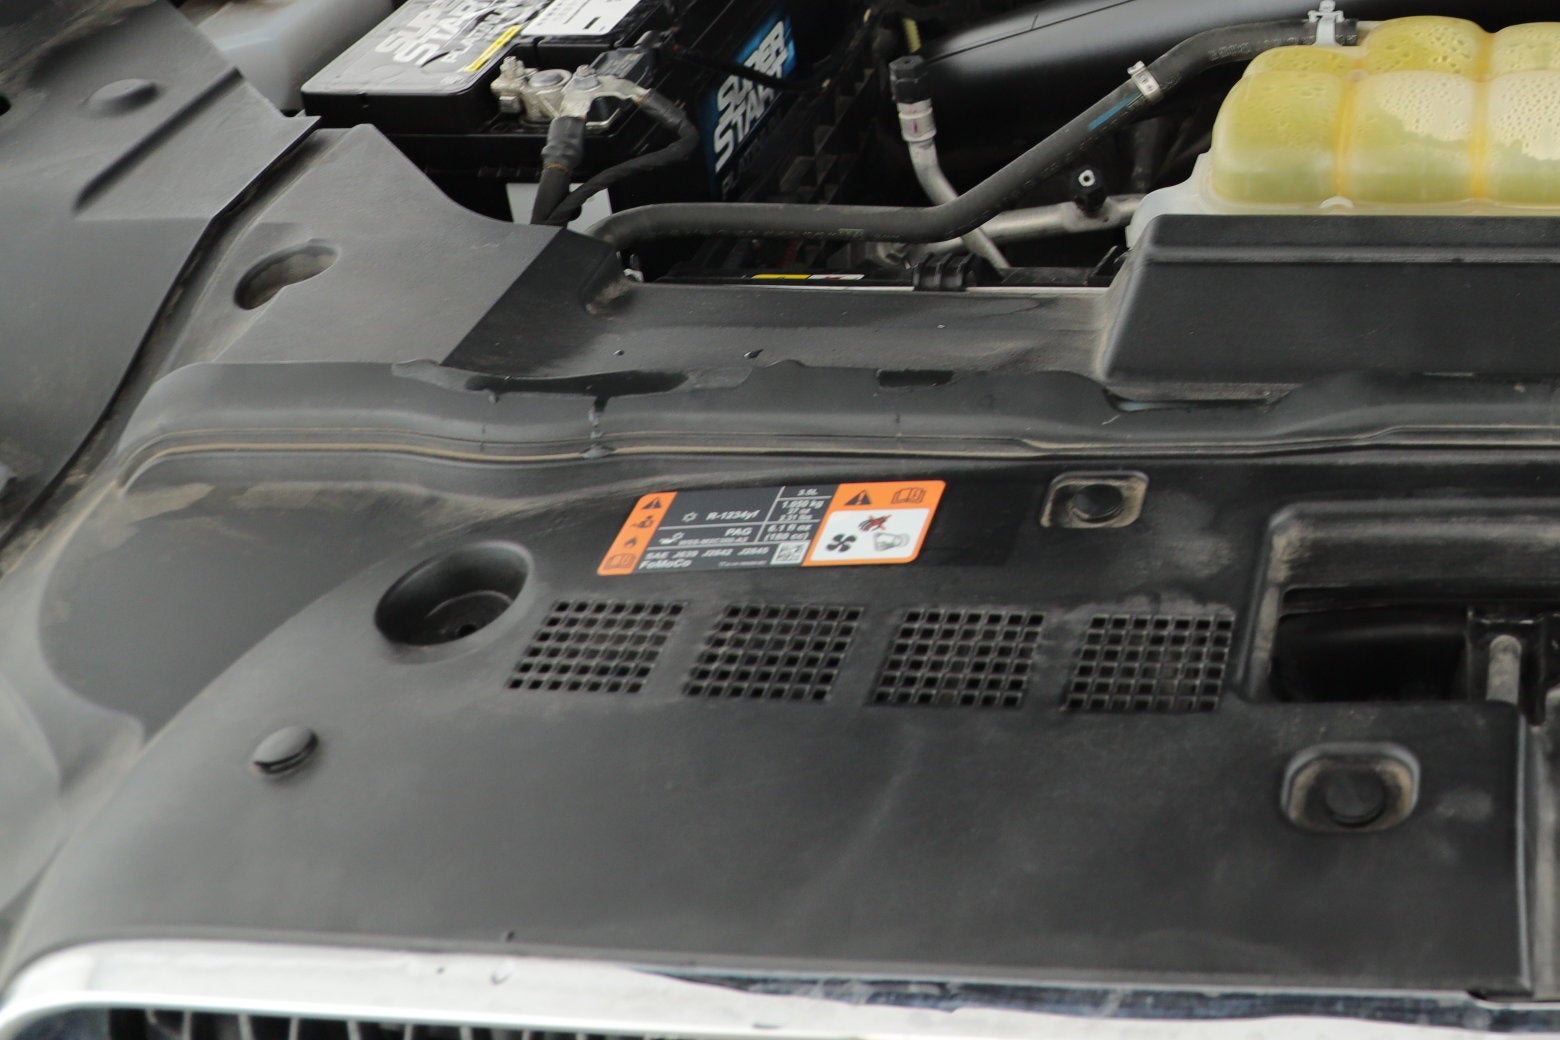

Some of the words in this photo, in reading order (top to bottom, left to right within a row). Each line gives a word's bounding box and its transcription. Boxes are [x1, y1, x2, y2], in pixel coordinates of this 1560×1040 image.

[705, 509, 760, 521] R-1234yf
[724, 527, 753, 537] PAG
[638, 559, 692, 569] FoMoCo
